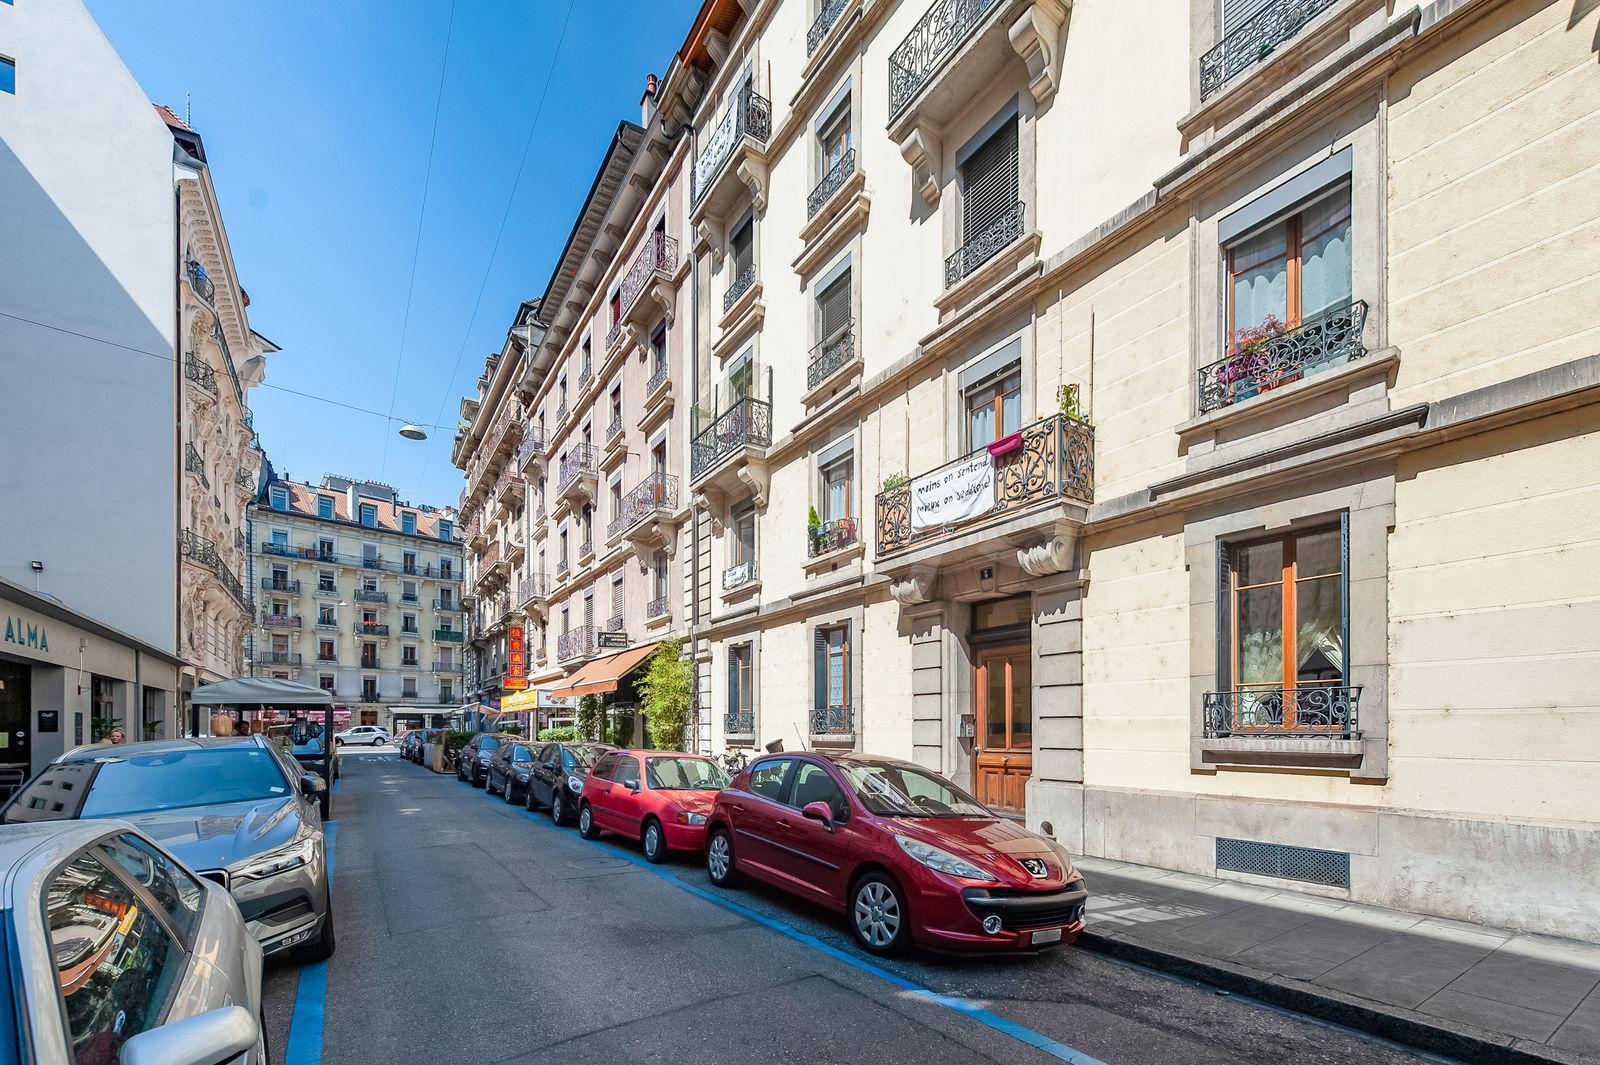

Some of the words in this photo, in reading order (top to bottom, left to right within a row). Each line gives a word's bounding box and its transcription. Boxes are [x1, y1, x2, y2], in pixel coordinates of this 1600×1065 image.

[944, 473, 954, 484] on
[944, 495, 954, 504] on
[5, 615, 49, 652] ALMA
